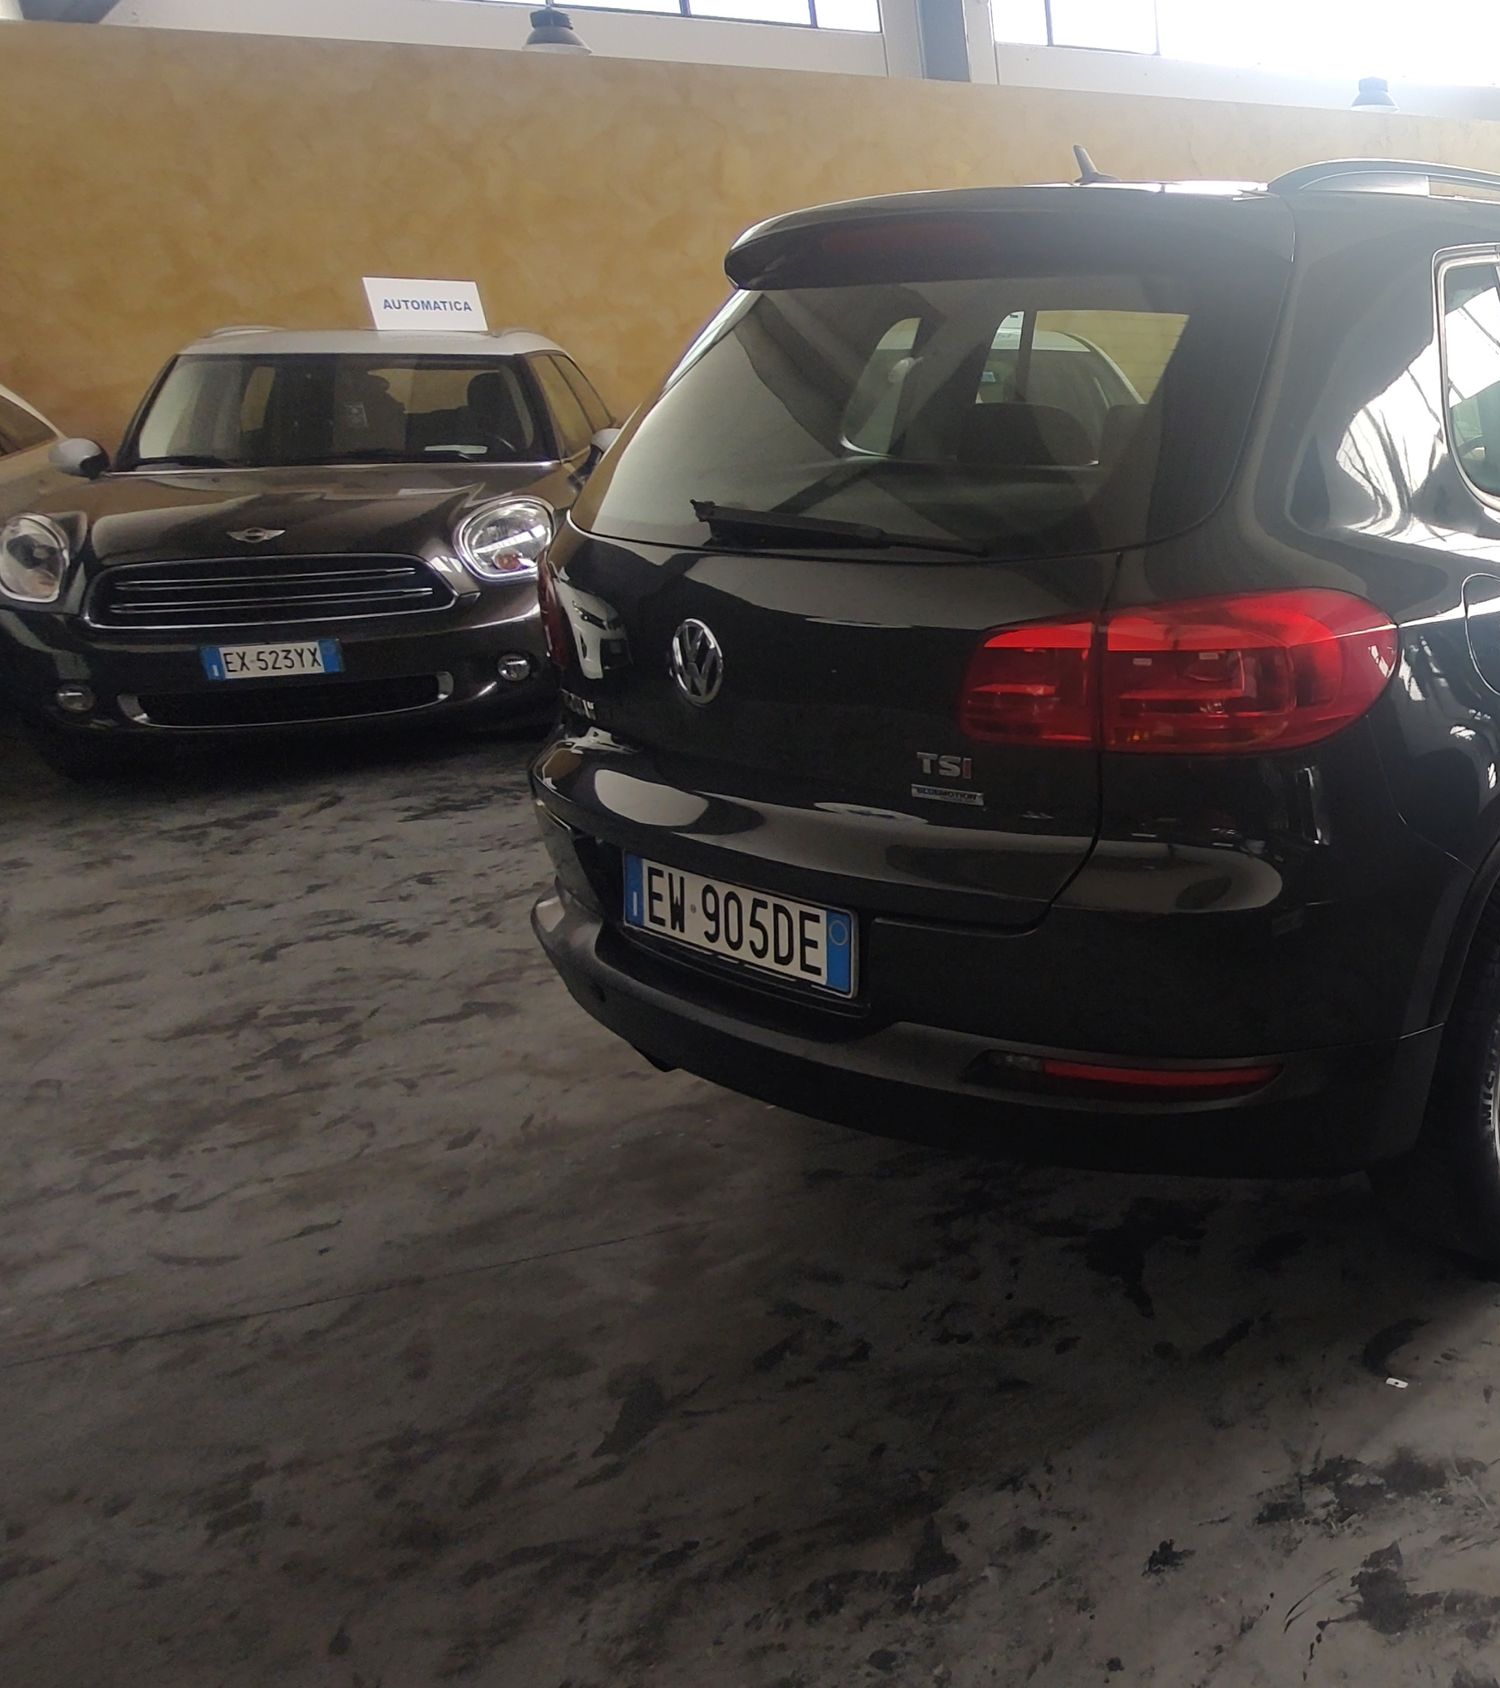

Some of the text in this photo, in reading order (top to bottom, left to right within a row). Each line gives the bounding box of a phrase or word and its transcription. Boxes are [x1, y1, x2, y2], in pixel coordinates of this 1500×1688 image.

[383, 298, 472, 312] AUTOMATICA
[223, 647, 322, 673] EX 523YX
[916, 751, 972, 779] TSI
[647, 866, 823, 976] EW 905DE
